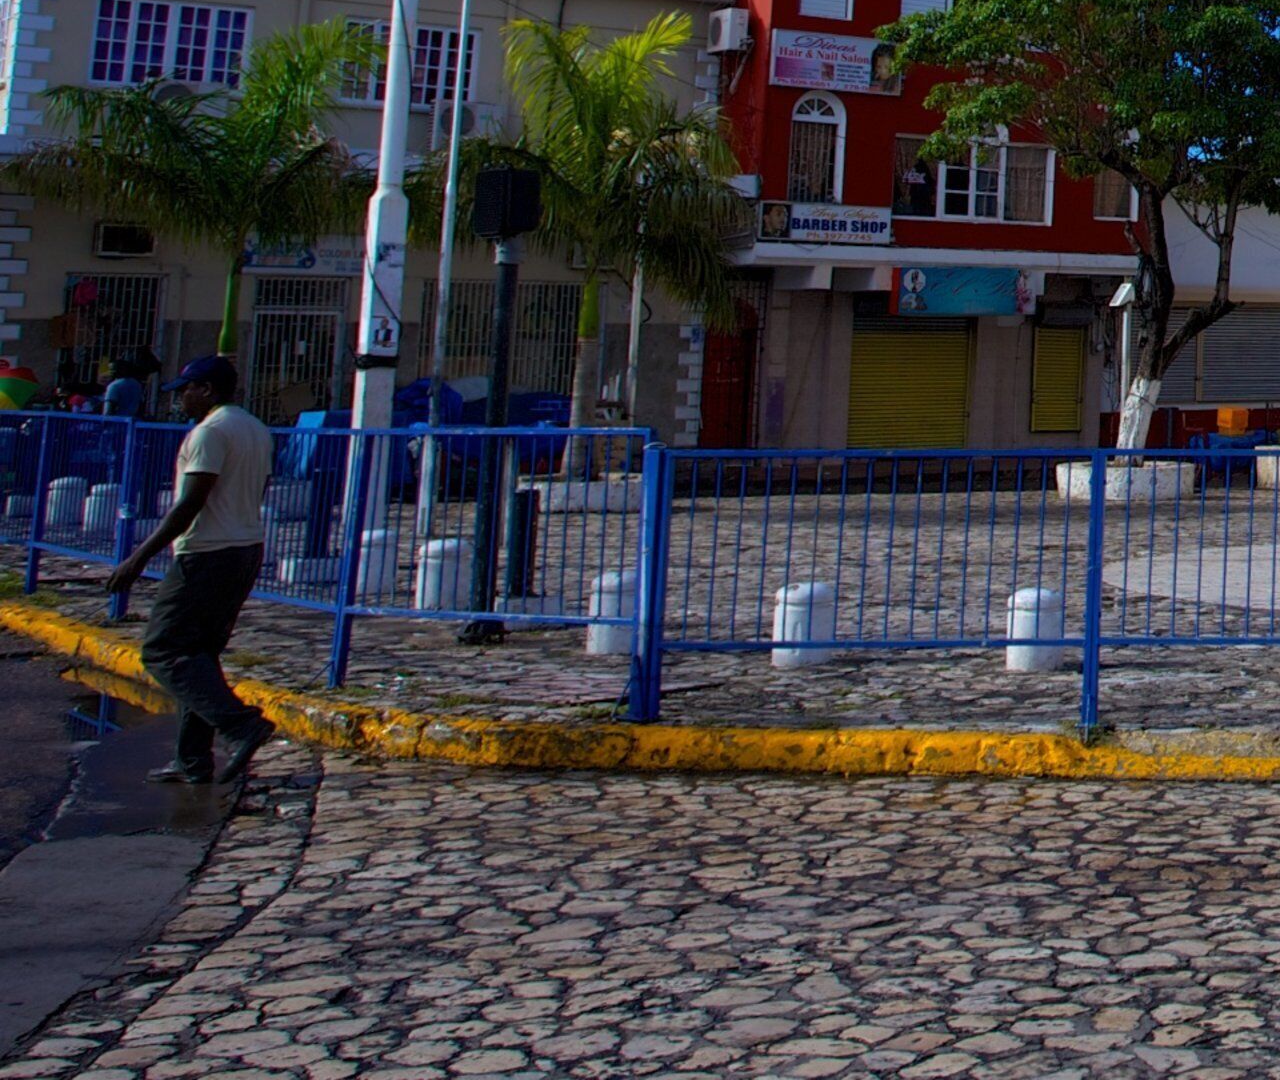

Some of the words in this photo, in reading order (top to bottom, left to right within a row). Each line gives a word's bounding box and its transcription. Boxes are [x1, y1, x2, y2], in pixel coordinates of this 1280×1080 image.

[792, 34, 856, 53] Divas
[779, 46, 802, 57] Hair
[805, 50, 813, 58] &
[817, 50, 838, 61] Nail
[841, 54, 869, 64] Salon
[791, 218, 847, 232] BARBER
[851, 220, 887, 233] SHOP
